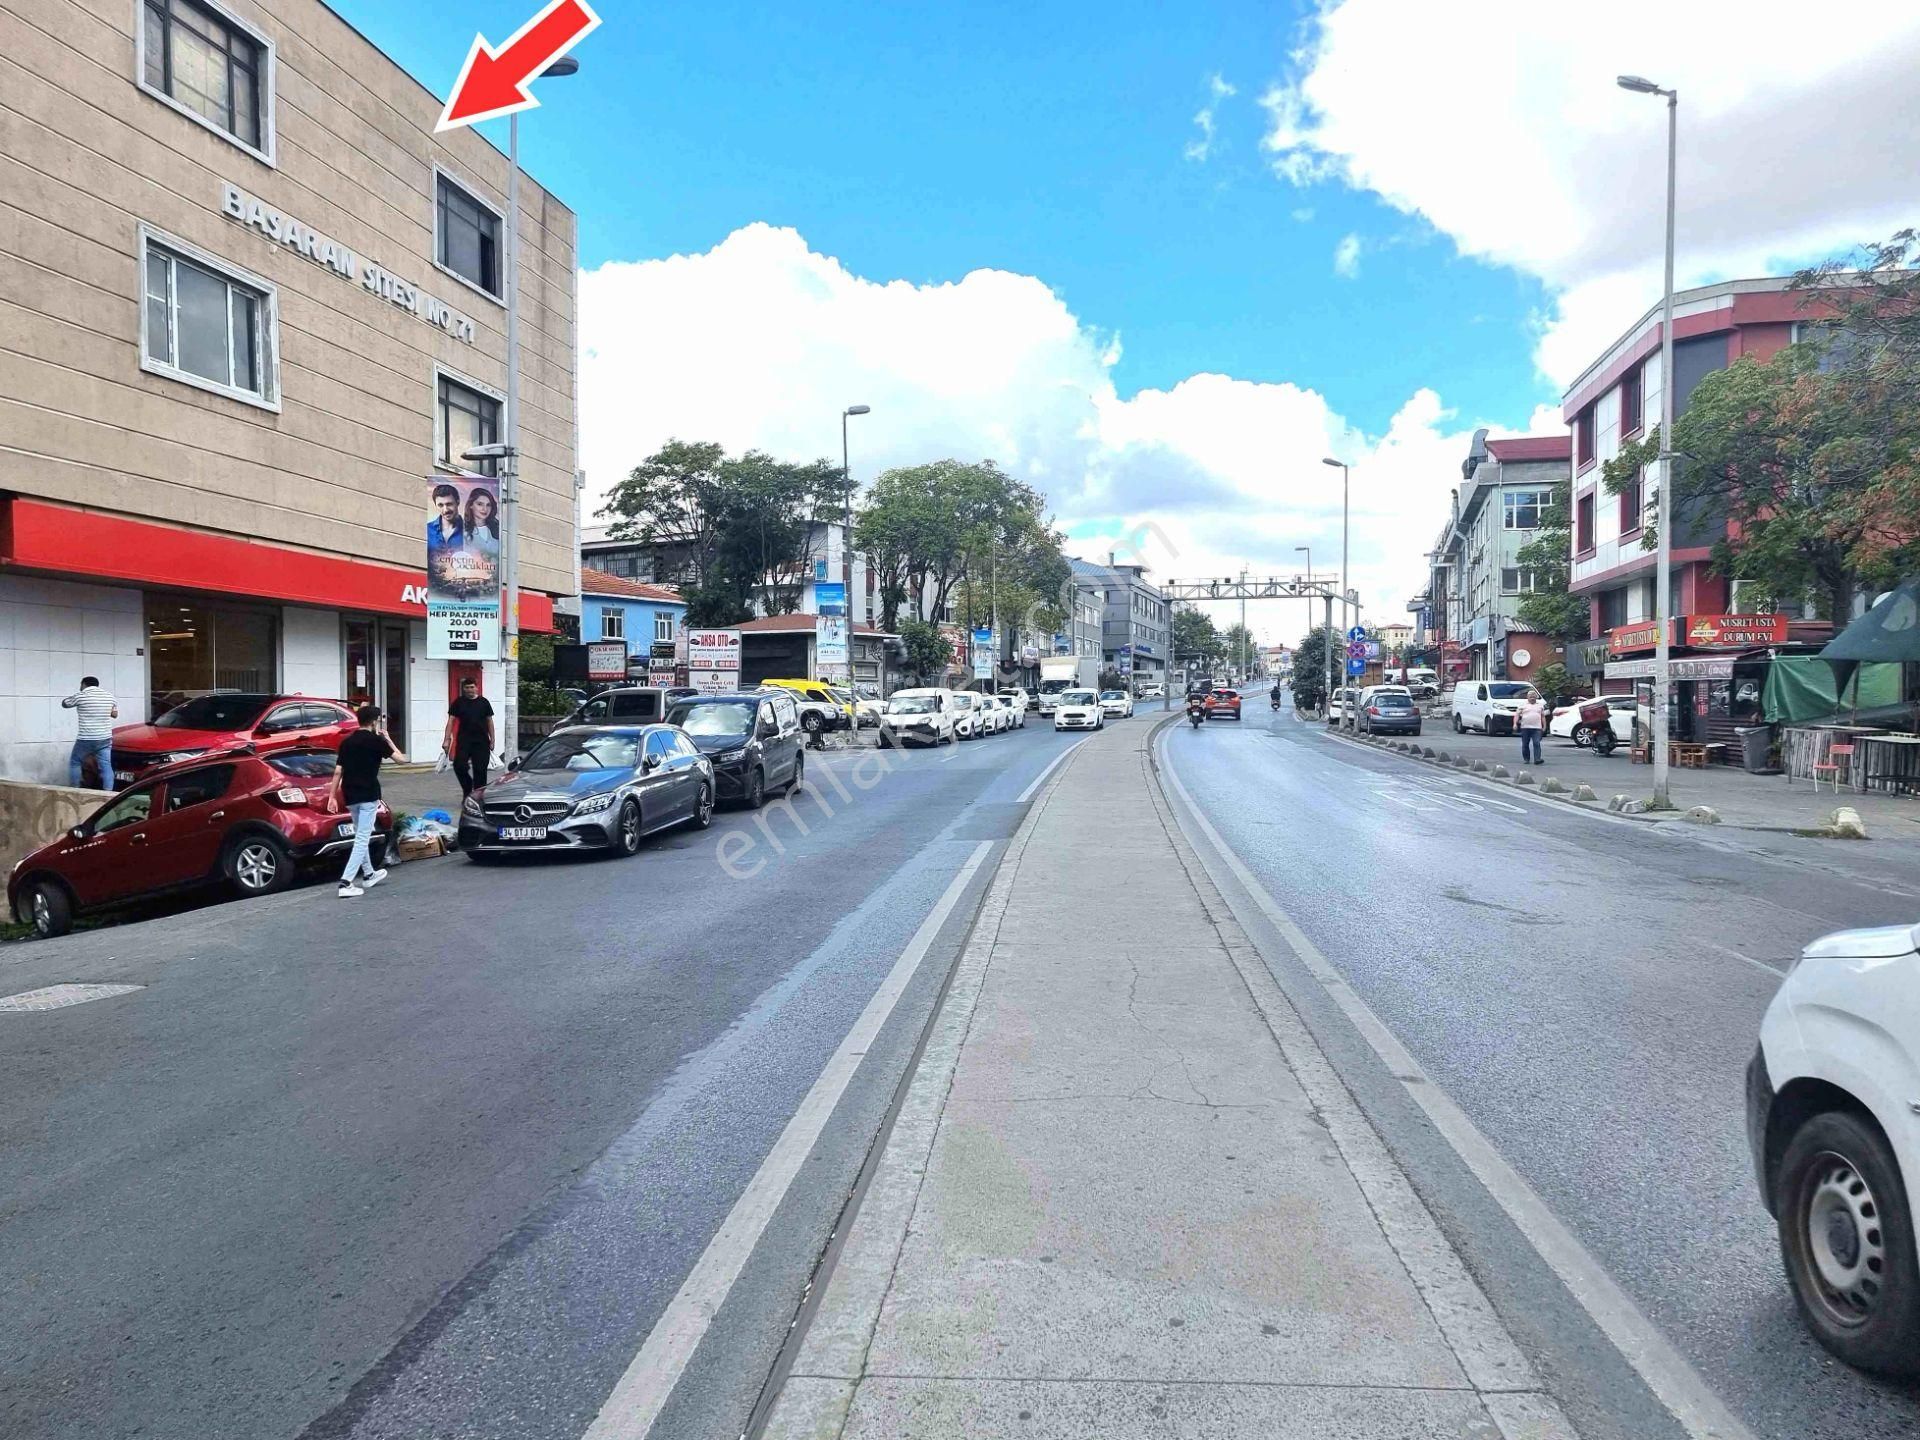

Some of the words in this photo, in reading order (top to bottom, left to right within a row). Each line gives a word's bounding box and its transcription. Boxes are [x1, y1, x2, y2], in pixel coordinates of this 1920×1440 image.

[449, 611, 498, 619] PAZARTESİ
[449, 618, 478, 626] 20.00
[1720, 618, 1754, 627] NUSRET
[1755, 618, 1777, 627] USTA
[1723, 629, 1755, 641] DÜRÜM
[1756, 630, 1774, 641] EVİ
[530, 828, 545, 837] 070
